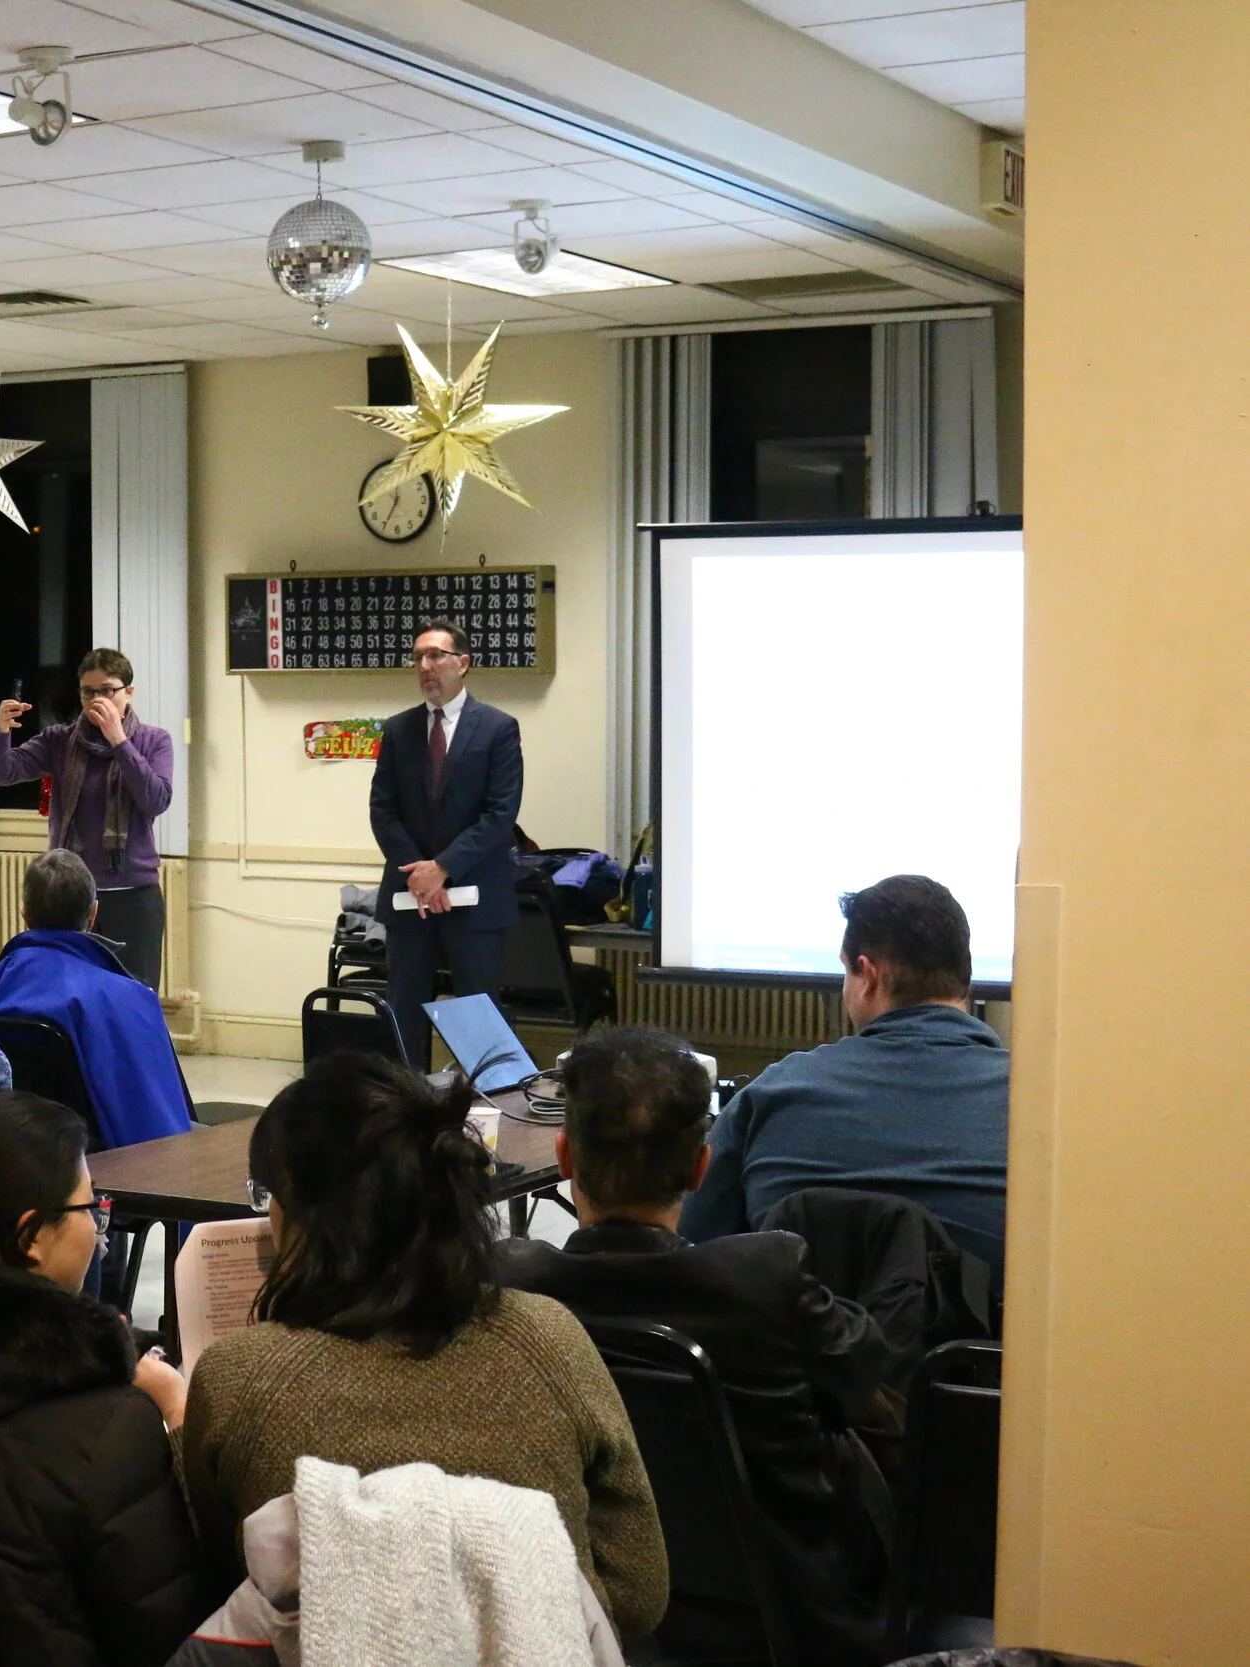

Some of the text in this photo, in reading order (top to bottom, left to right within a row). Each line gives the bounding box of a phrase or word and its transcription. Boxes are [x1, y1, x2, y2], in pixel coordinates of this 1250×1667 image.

[417, 482, 422, 491] 2
[421, 495, 426, 504] 3
[372, 512, 377, 520] 8
[417, 510, 423, 518] 4
[382, 521, 387, 530] 7
[394, 525, 400, 534] 6
[407, 520, 413, 529] 5
[288, 575, 535, 592] 1 2 3 4 5 6 7 8 9 10 11 12 13 14 15
[285, 594, 535, 612] 16 17 18 19 20 21 22 23 24 25 26 27 28 29 30
[285, 618, 296, 631] 31
[301, 618, 312, 631] 32
[318, 618, 329, 630] 33
[334, 617, 346, 630] 34
[351, 617, 362, 630] 35
[367, 616, 378, 629] 36
[383, 616, 395, 629] 37
[402, 615, 413, 629] 38
[471, 614, 482, 628] 42
[488, 614, 500, 627] 43
[506, 614, 518, 627] 44
[524, 614, 535, 627] 45
[285, 635, 413, 649] 46 47 48 49 50 51 52 53
[471, 633, 535, 647] 57 58 59 60
[286, 655, 296, 668] 61
[302, 655, 312, 667] 62
[318, 655, 330, 667] 63
[334, 654, 345, 667] 64
[351, 654, 362, 667] 65
[368, 654, 379, 667] 66
[384, 654, 395, 667] 67
[472, 653, 535, 666] 72 73 74 75
[315, 737, 375, 755] FELIZ
[201, 1237, 239, 1248] Progress
